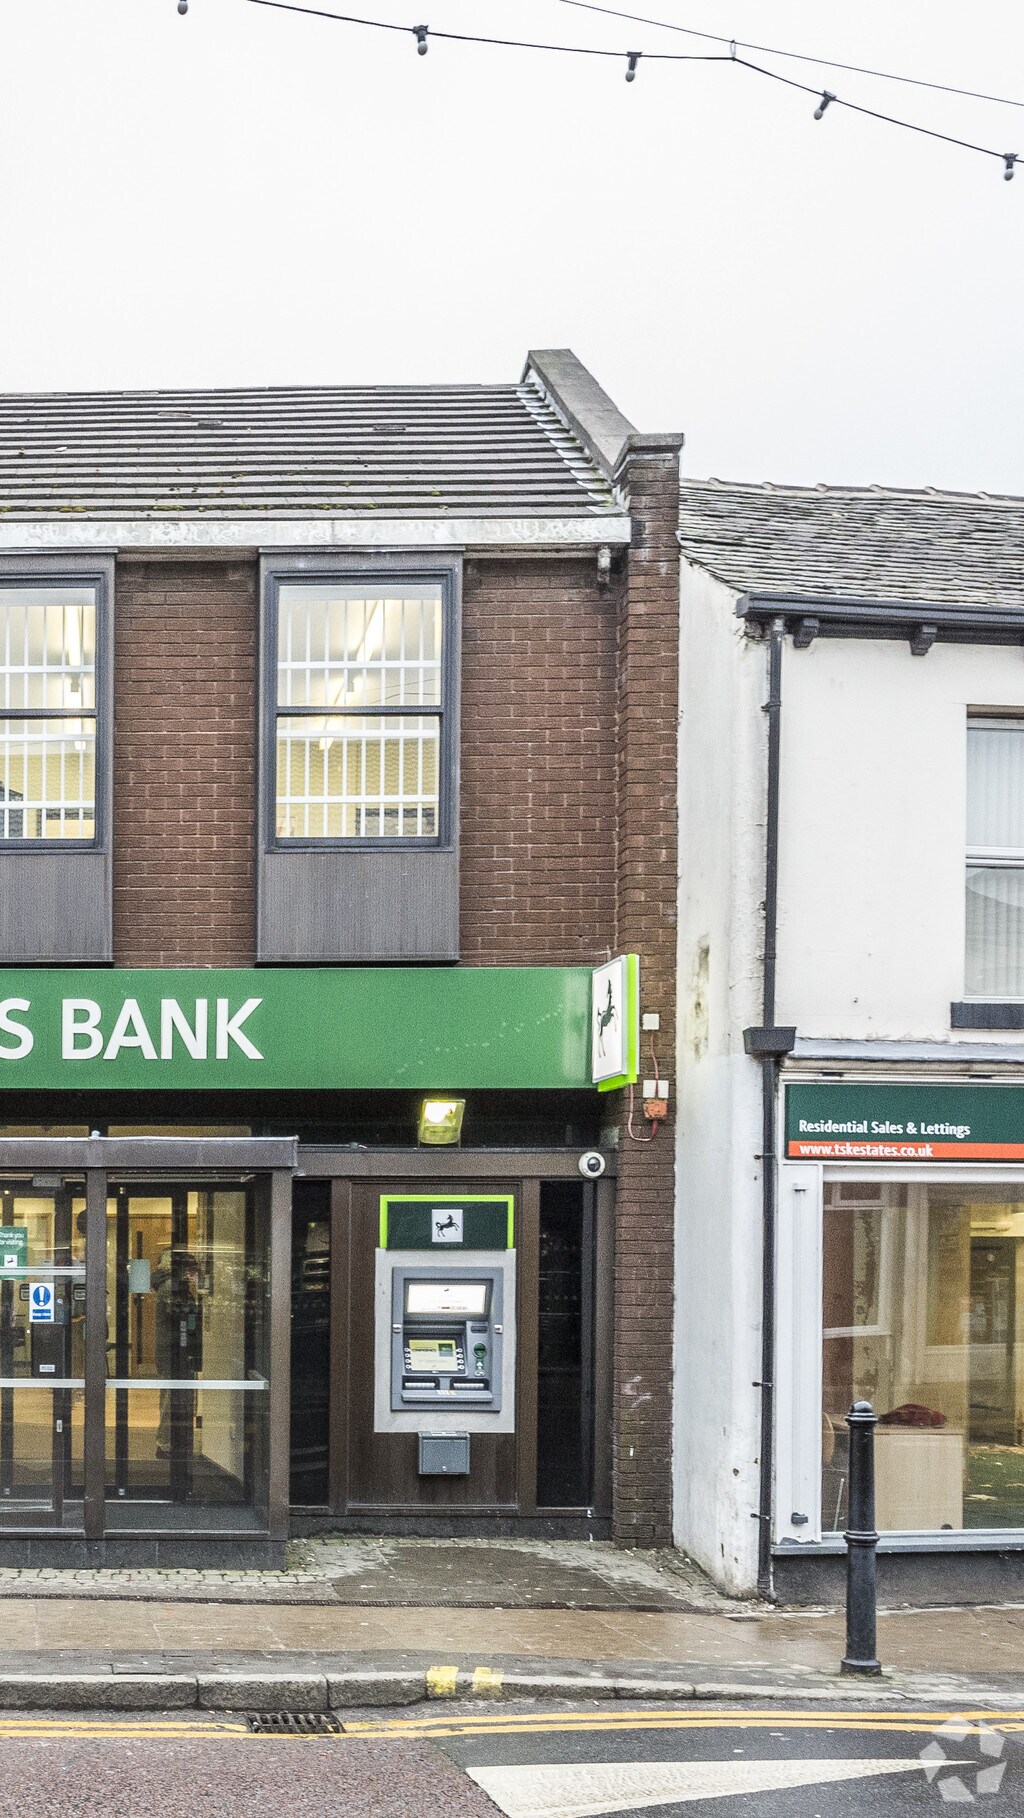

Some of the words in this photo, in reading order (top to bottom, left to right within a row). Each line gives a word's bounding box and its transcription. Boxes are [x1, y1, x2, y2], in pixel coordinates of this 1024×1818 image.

[61, 998, 265, 1061] BANK
[799, 1119, 868, 1133] Residential
[871, 1121, 904, 1135] Sales
[906, 1122, 917, 1135] &
[920, 1122, 971, 1139] Lettings
[799, 1142, 934, 1157] www.tskestates.co.uk
[13, 1233, 25, 1241] you
